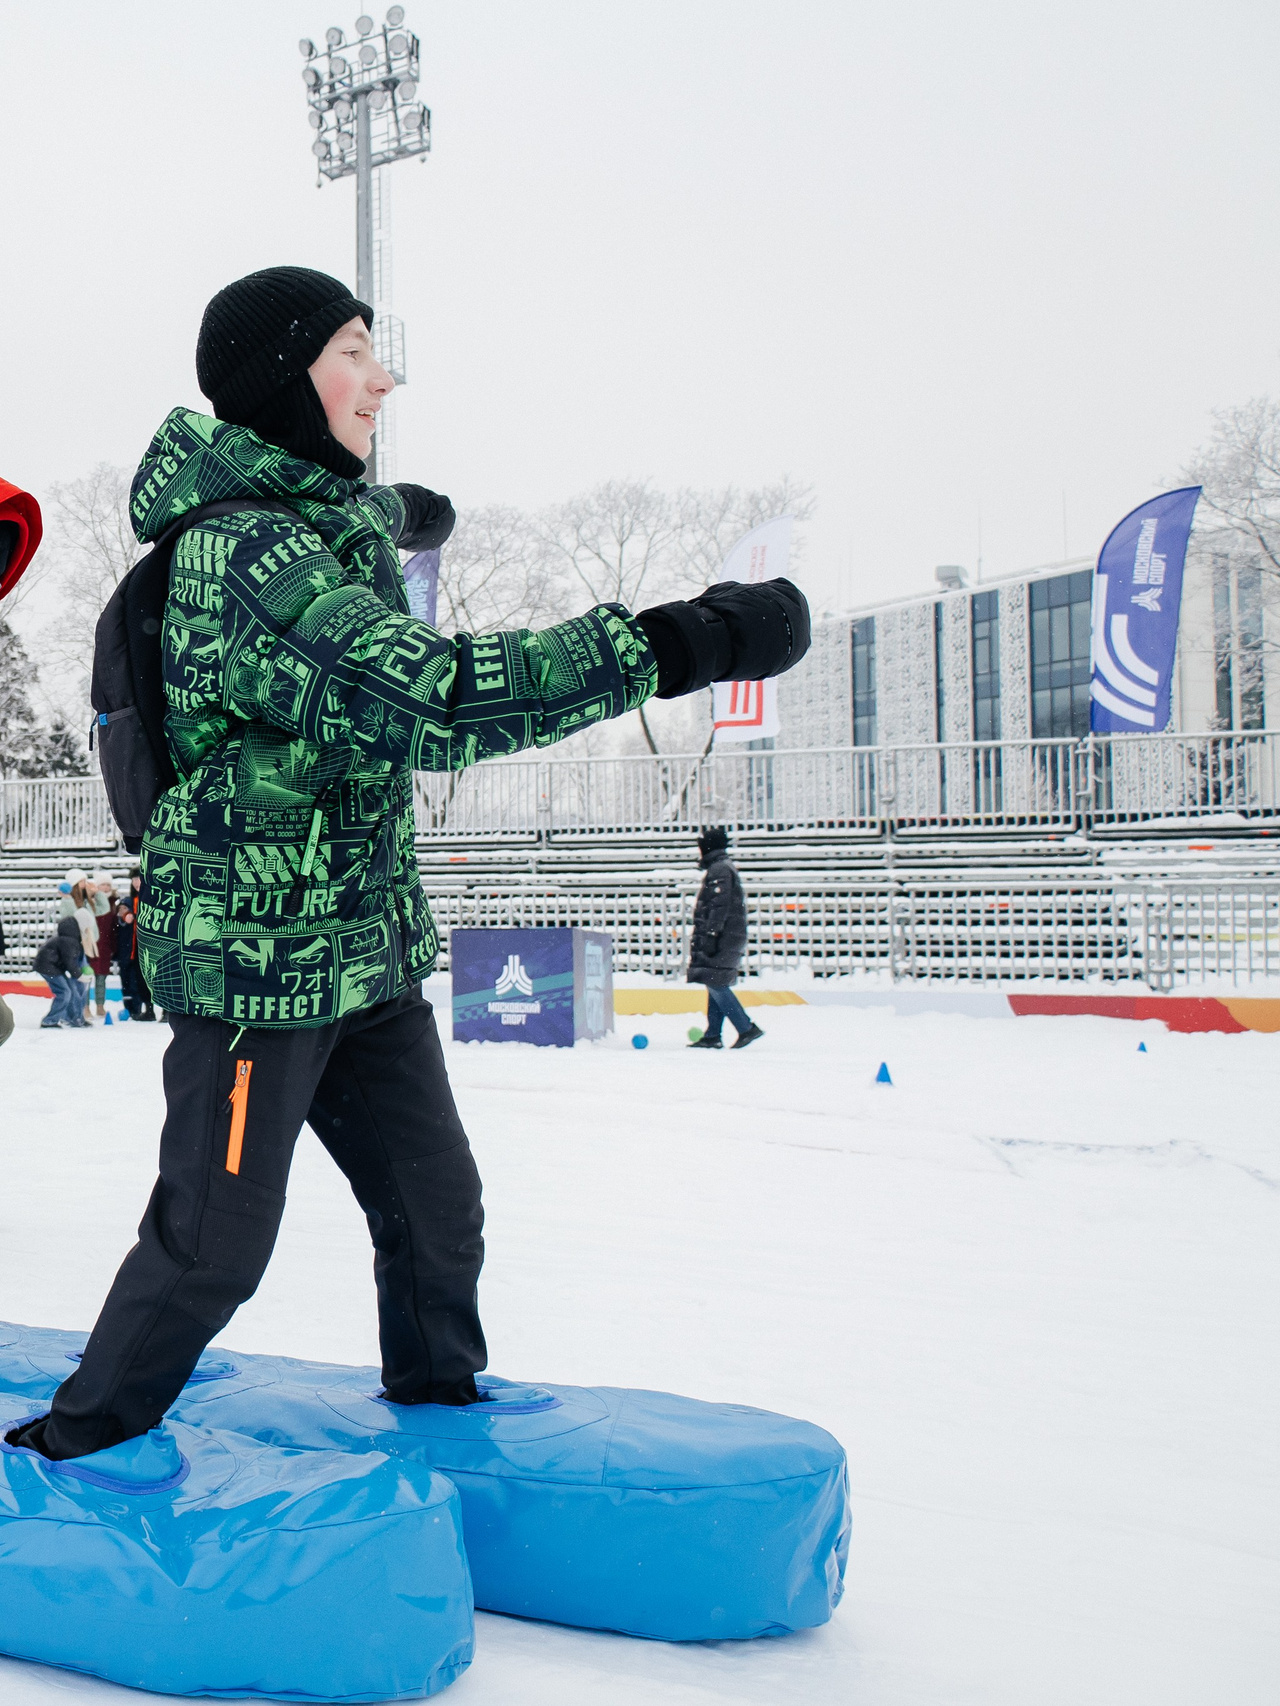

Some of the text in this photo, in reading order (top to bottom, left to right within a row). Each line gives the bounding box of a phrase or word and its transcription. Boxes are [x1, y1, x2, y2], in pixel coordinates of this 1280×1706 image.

[1148, 552, 1167, 585] СПОРТ
[331, 622, 354, 643] MOTION
[375, 644, 393, 669] FOCUS
[586, 641, 604, 667] MOTION
[184, 666, 223, 693] ワオ!
[281, 966, 333, 994] ワオ!
[233, 992, 324, 1020] EFFECT
